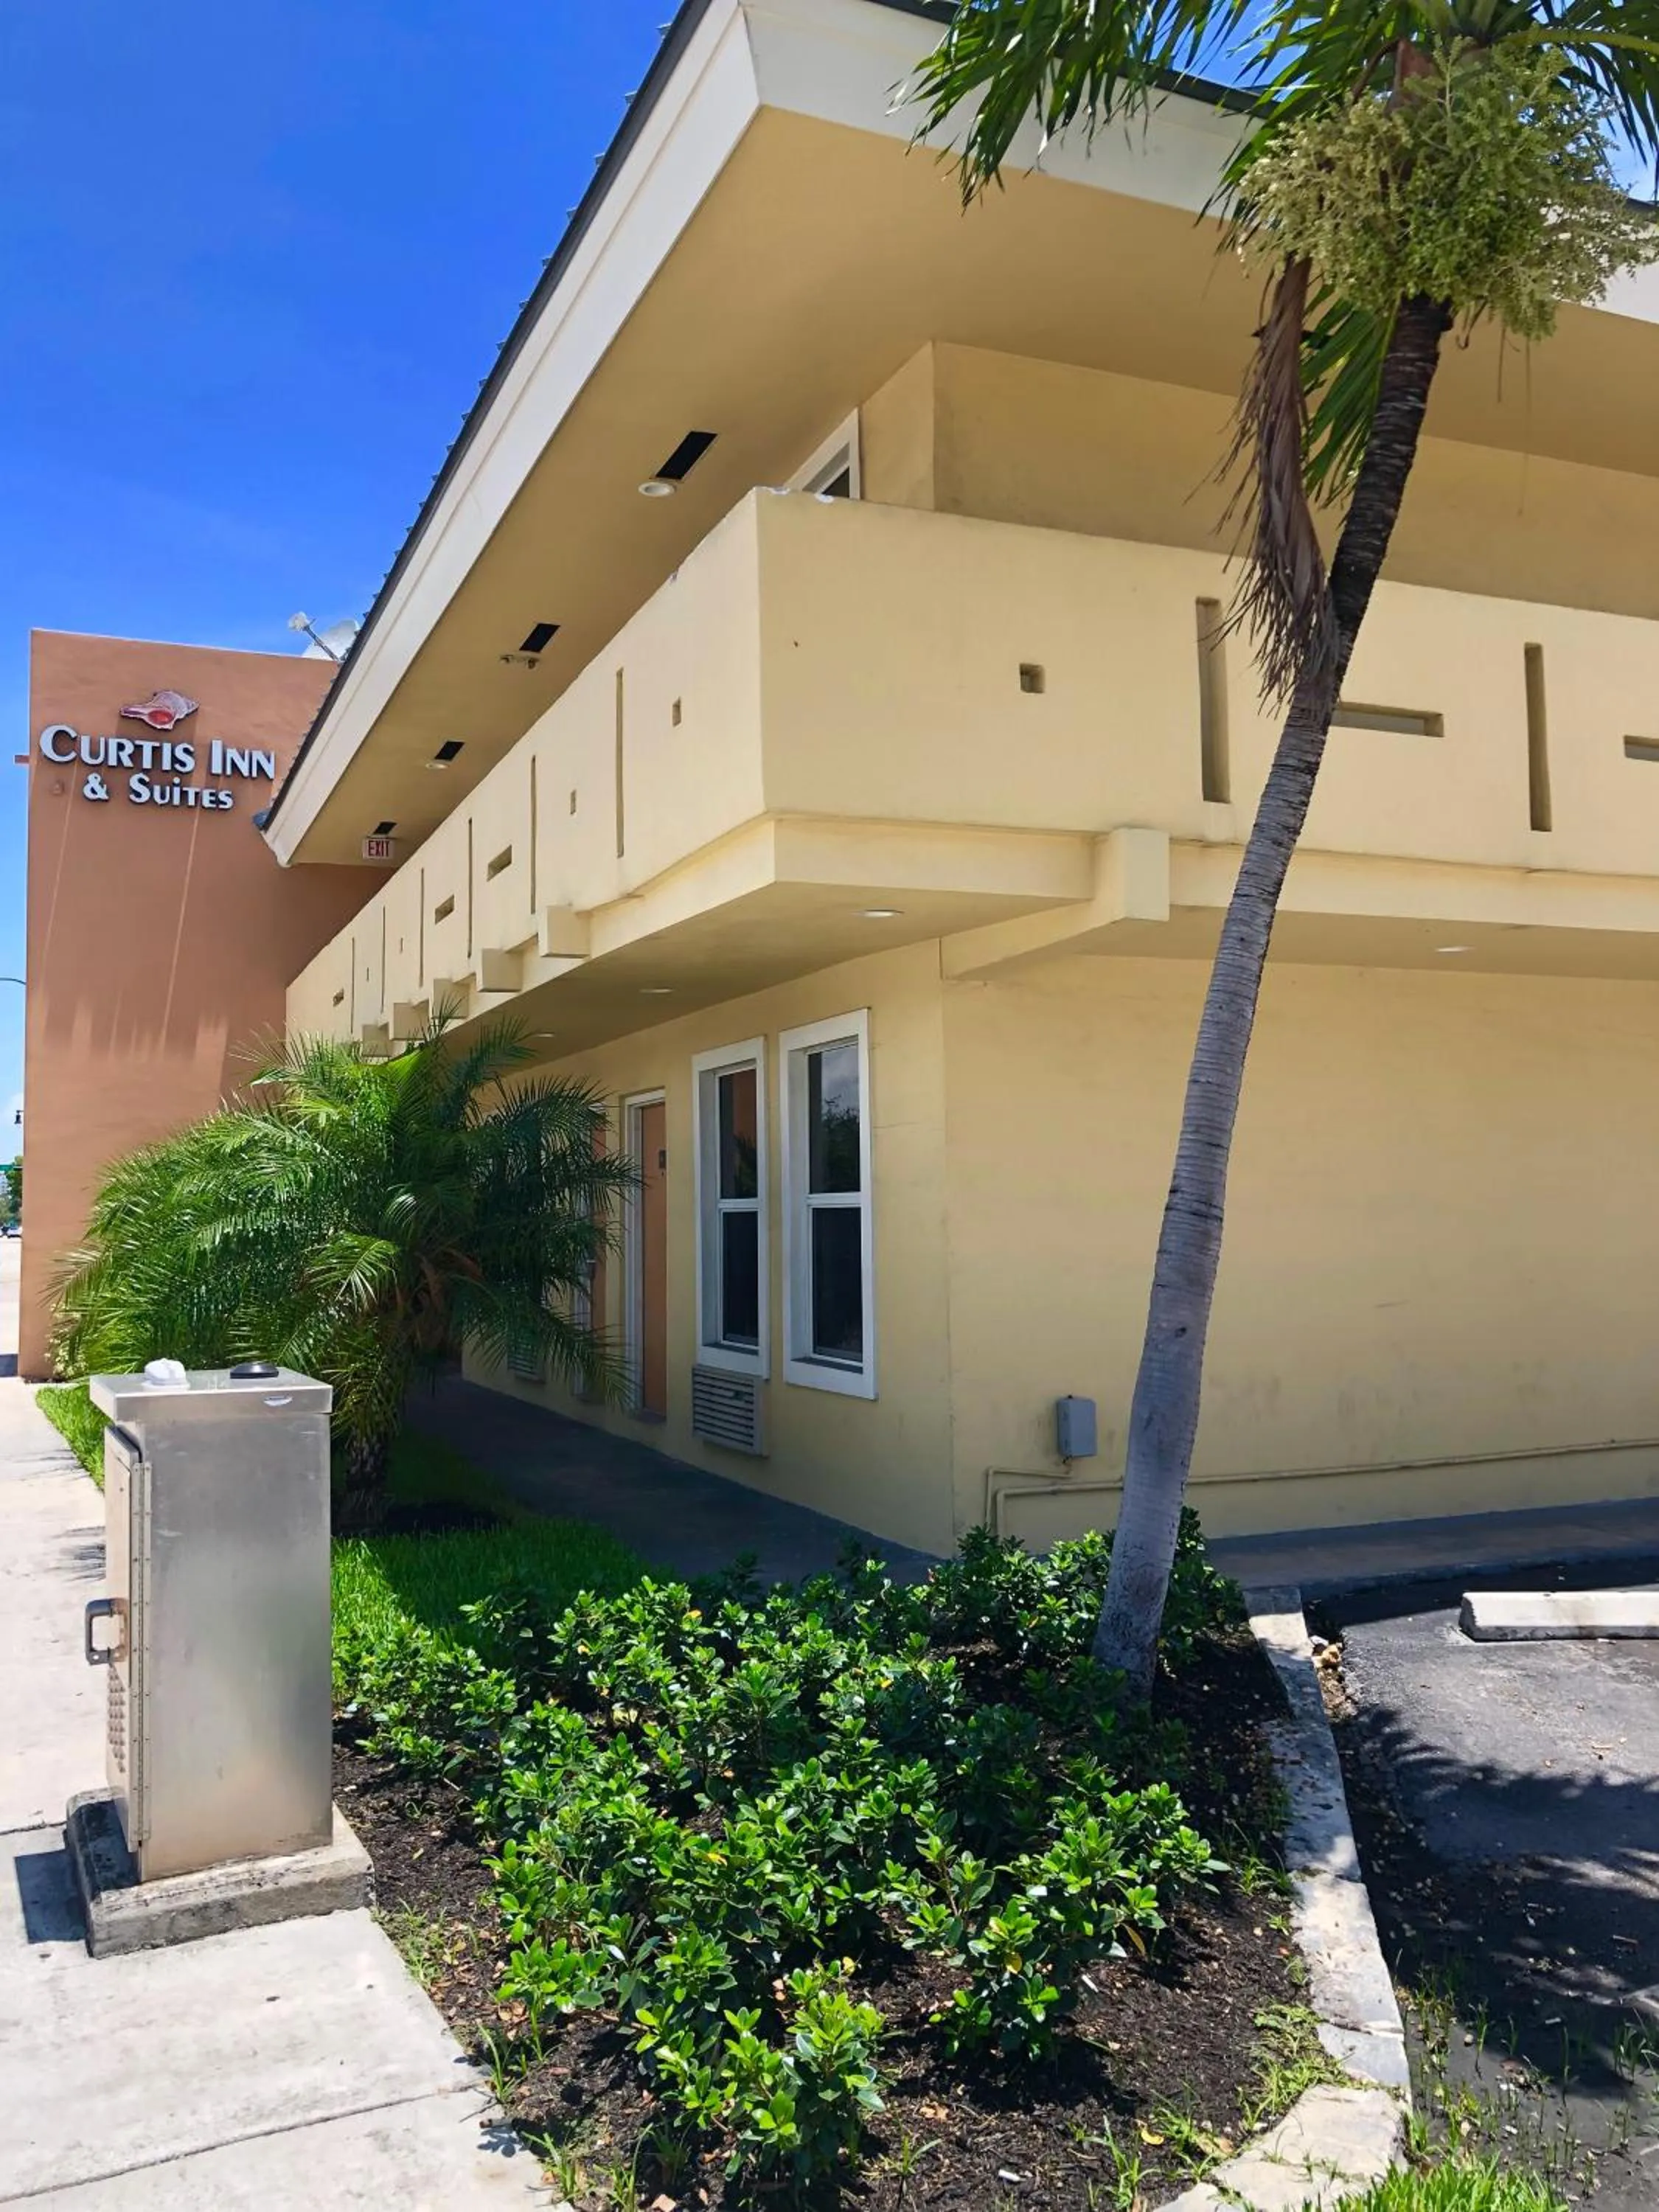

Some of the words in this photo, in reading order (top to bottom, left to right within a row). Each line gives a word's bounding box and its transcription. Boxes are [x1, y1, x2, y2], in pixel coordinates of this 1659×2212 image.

[39, 724, 196, 774] CURTIS
[211, 740, 275, 779] INN
[82, 773, 109, 801] &
[368, 840, 390, 857] EXIT
